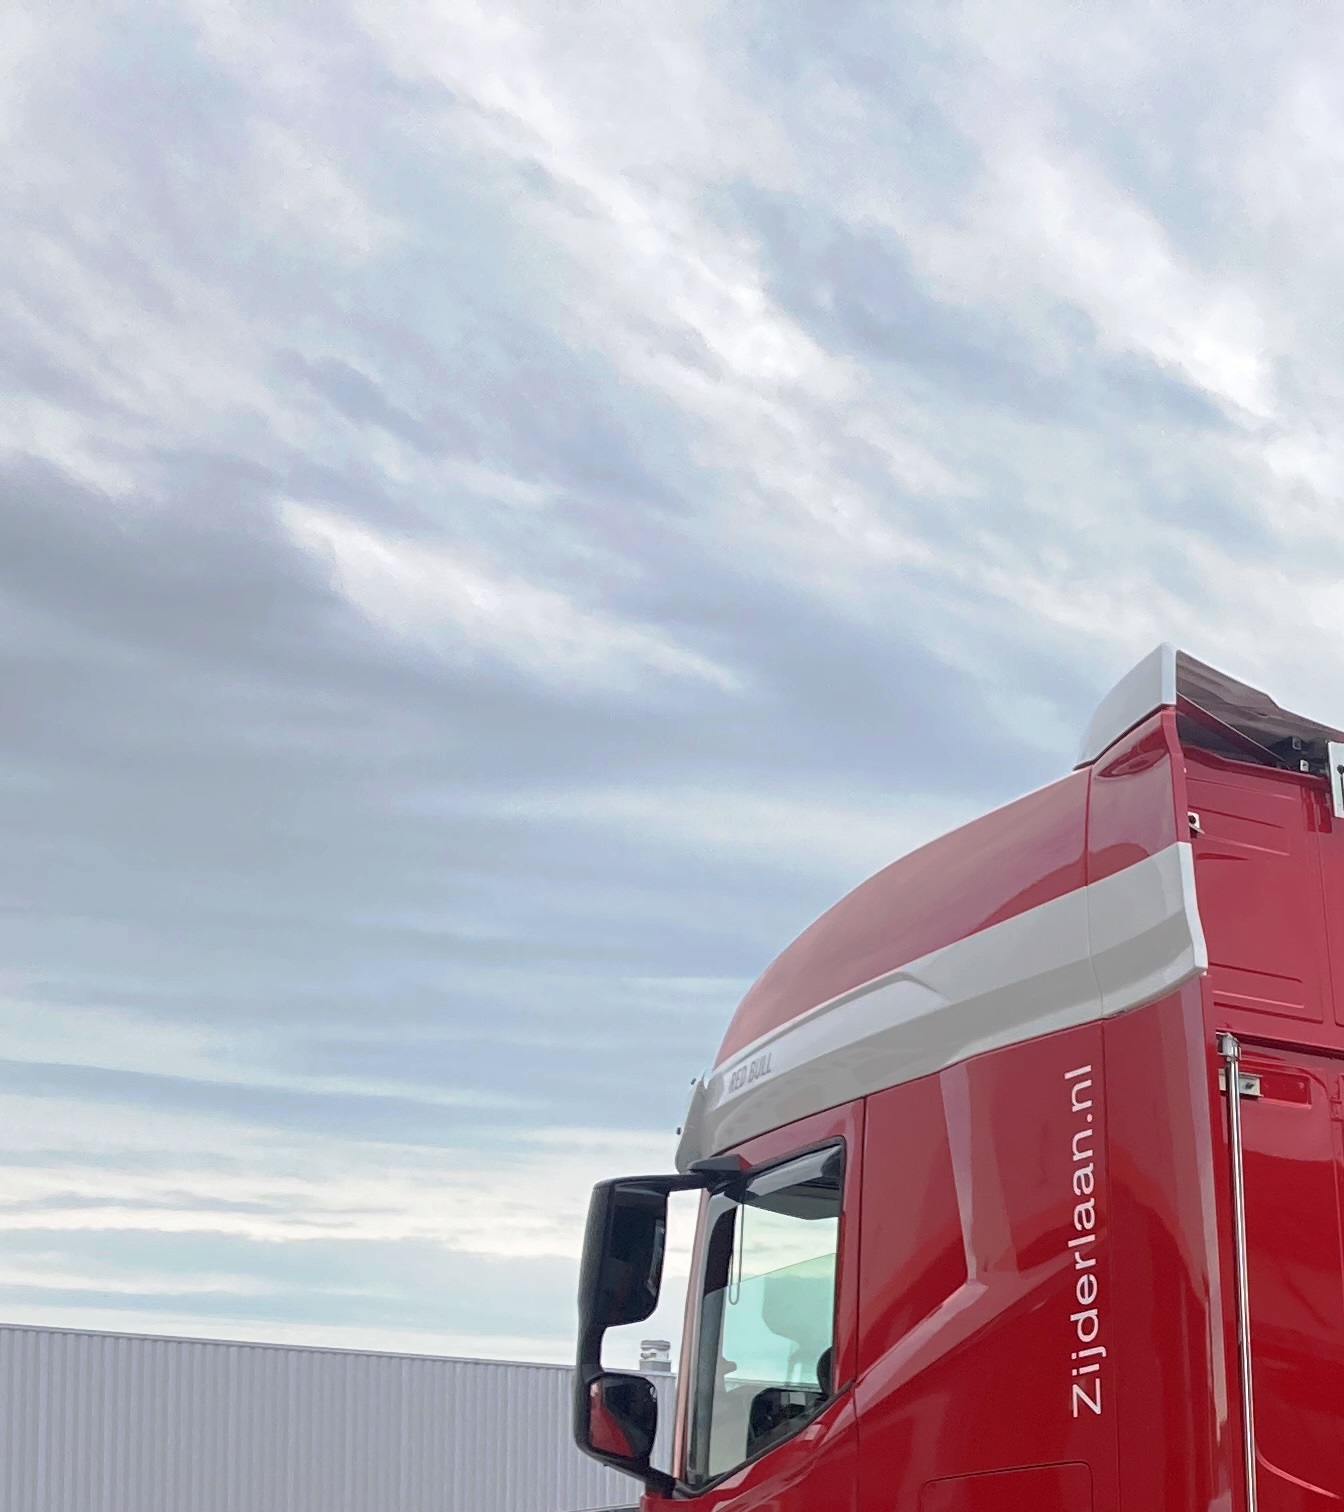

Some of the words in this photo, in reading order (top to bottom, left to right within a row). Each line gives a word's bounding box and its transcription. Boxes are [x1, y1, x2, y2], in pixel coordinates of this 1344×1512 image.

[729, 1065, 747, 1093] RED
[748, 1052, 772, 1083] BULL
[1064, 1064, 1106, 1418] Zijderlaan.nl
